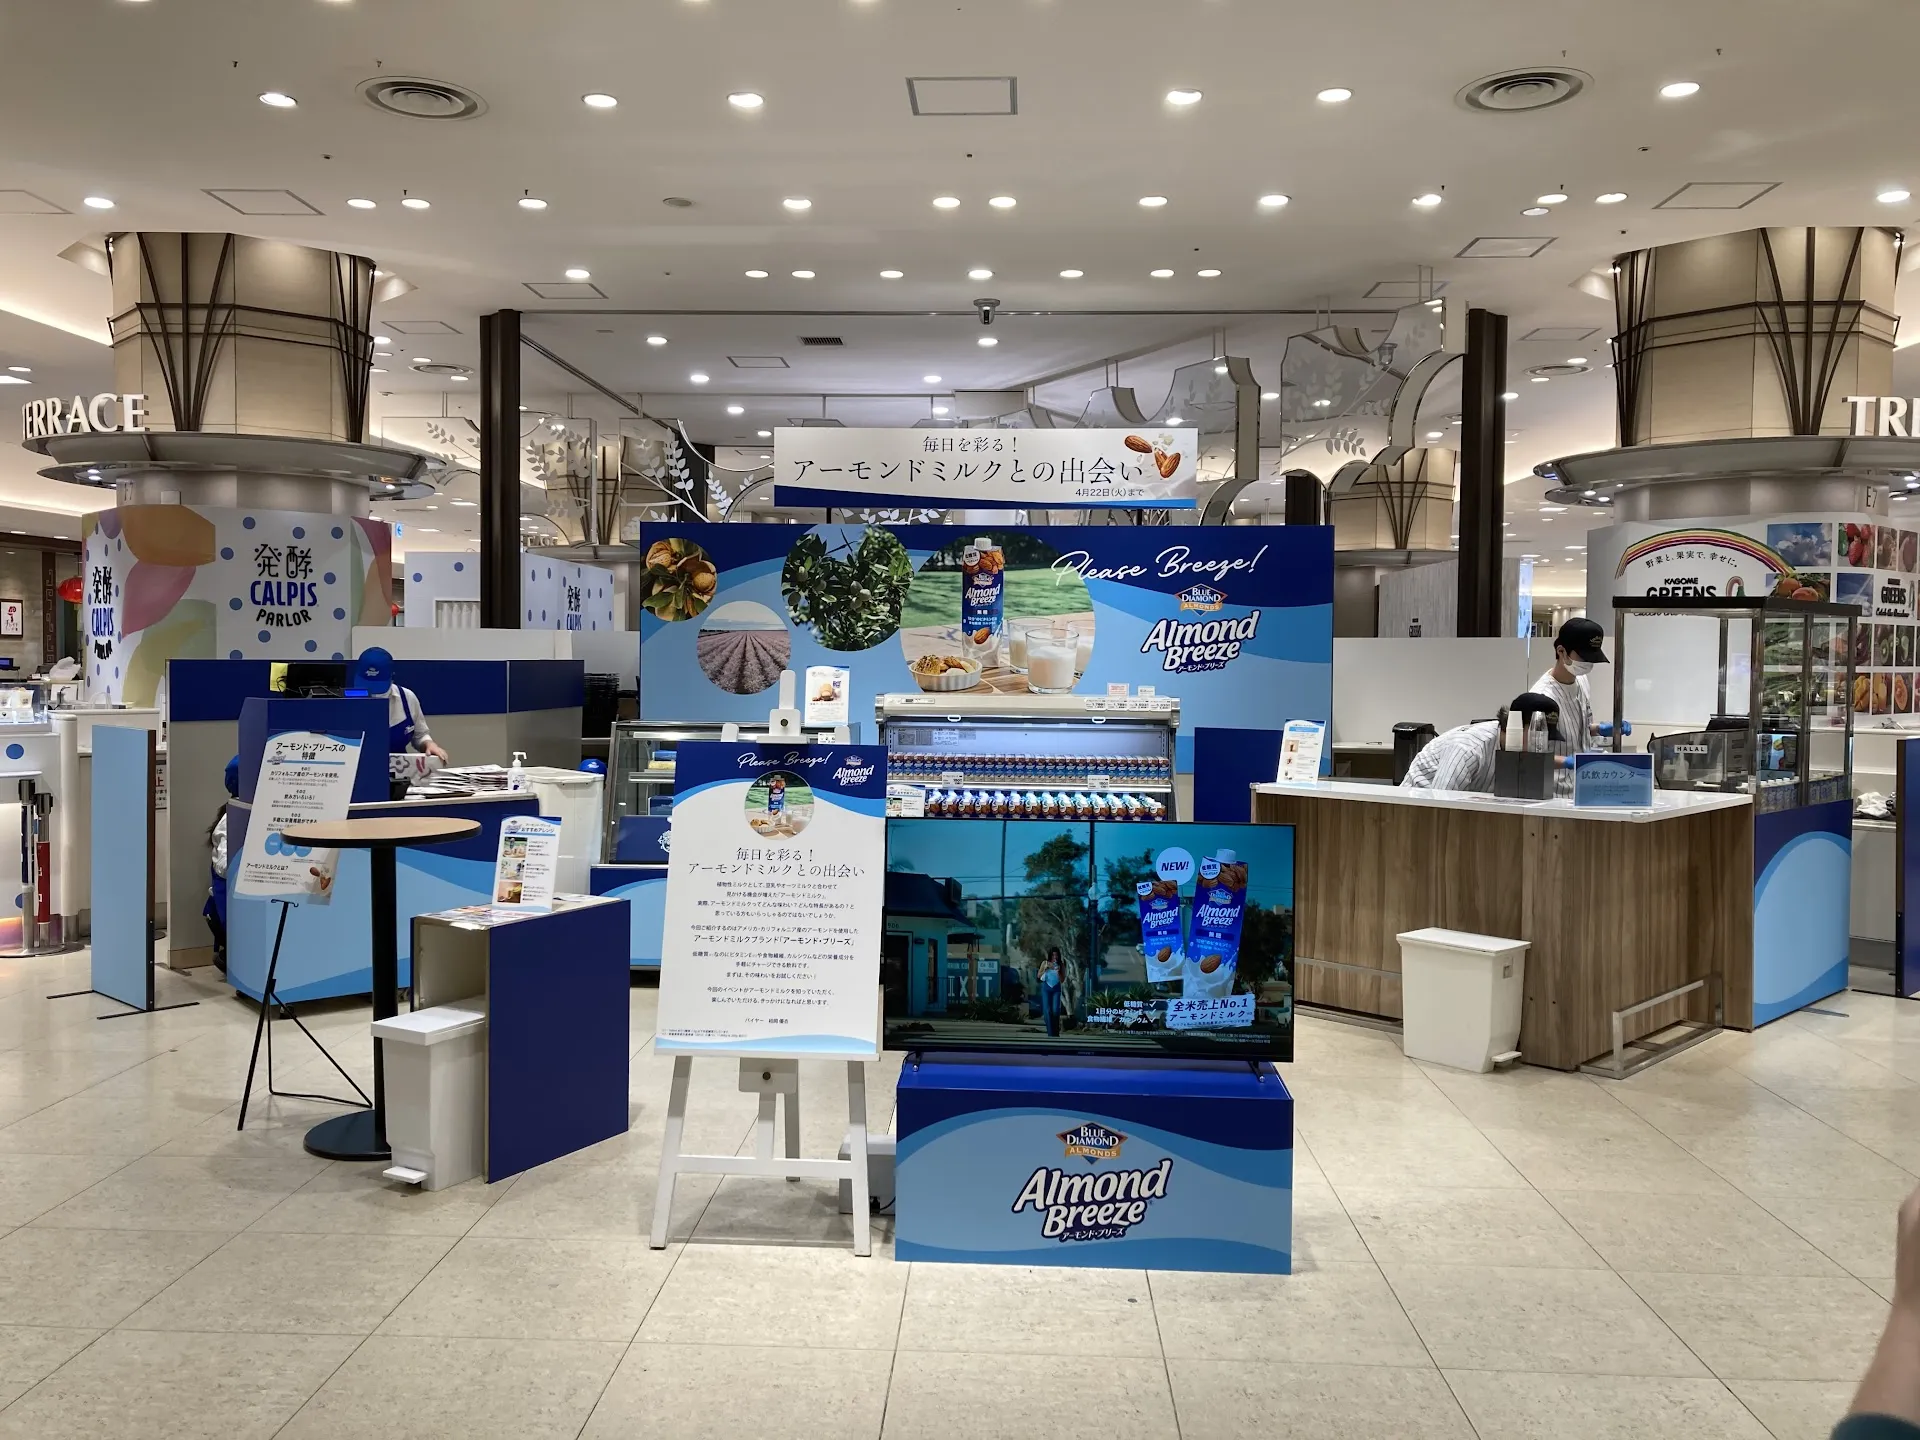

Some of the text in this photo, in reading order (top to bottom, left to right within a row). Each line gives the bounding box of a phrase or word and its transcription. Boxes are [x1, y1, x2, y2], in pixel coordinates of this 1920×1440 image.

[922, 435, 1018, 453] 毎日を彩る！
[794, 457, 1143, 484] アーモンドミルクとの出会い
[1866, 485, 1878, 508] E7
[254, 544, 313, 579] 発酵
[1052, 544, 1268, 586] Please Breeze!
[1664, 577, 1699, 585] KAGOME
[250, 581, 317, 607] CALPIS
[965, 584, 1001, 599] Almond
[1181, 593, 1221, 602] DIAMOND
[1191, 587, 1212, 596] BLUE
[970, 595, 997, 606] Breeze
[1183, 602, 1220, 611] ALMONDS
[92, 607, 114, 637] CALPIS
[256, 608, 312, 627] PARLOR
[1141, 610, 1260, 653] Almond
[1163, 641, 1241, 672] Breeze
[1177, 661, 1225, 673] アーモンド・ブリーズ
[275, 742, 346, 752] アーモンド・ブリーズの
[737, 751, 833, 768] Please Breeze!
[833, 765, 875, 780] Almond
[1581, 770, 1647, 780] 試飲カウンター
[840, 776, 868, 786] Breeze
[736, 847, 814, 861] 毎日を彩る！
[689, 863, 865, 877] アーモンドミルクとの出会い
[1161, 861, 1189, 872] NEW!
[1142, 906, 1179, 924] Almond
[1196, 904, 1241, 919] Almond
[1150, 916, 1174, 929] Breeze
[1202, 915, 1234, 927] Breeze
[694, 935, 855, 946] アーモンドミルクブランド「アーモンド・ブリーズ」
[1173, 998, 1248, 1012] 全米売上No.1
[1080, 1126, 1106, 1138] BLUE
[1066, 1134, 1119, 1147] DIAMOND
[1069, 1147, 1117, 1157] ALMONDS
[1013, 1159, 1171, 1212] Almond
[1043, 1201, 1147, 1237] Breeze
[1061, 1228, 1125, 1240] アーモンド・ブリーズ
